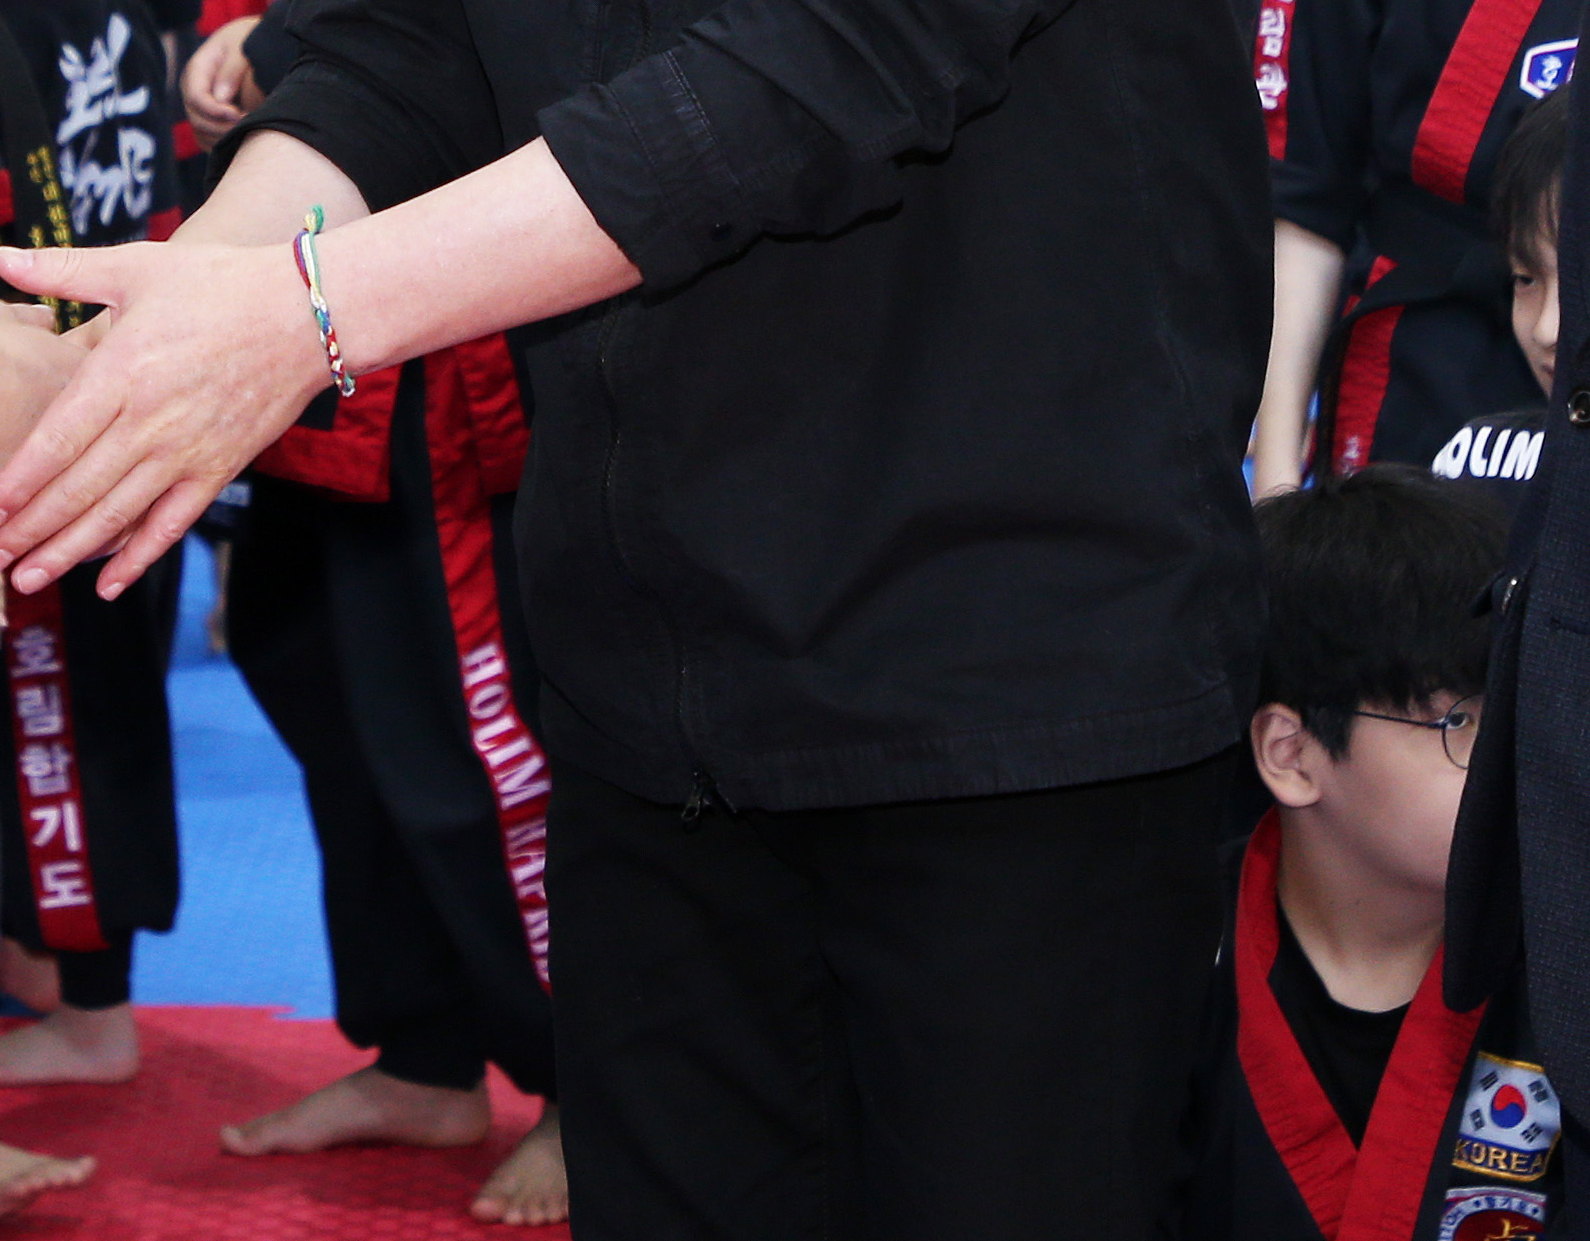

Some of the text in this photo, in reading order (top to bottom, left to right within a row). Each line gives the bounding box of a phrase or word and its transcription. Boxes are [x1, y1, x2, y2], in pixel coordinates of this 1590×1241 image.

[11, 625, 94, 911] 호림합기도
[461, 640, 553, 812] HOLIM
[1454, 1138, 1548, 1174] KOREA
